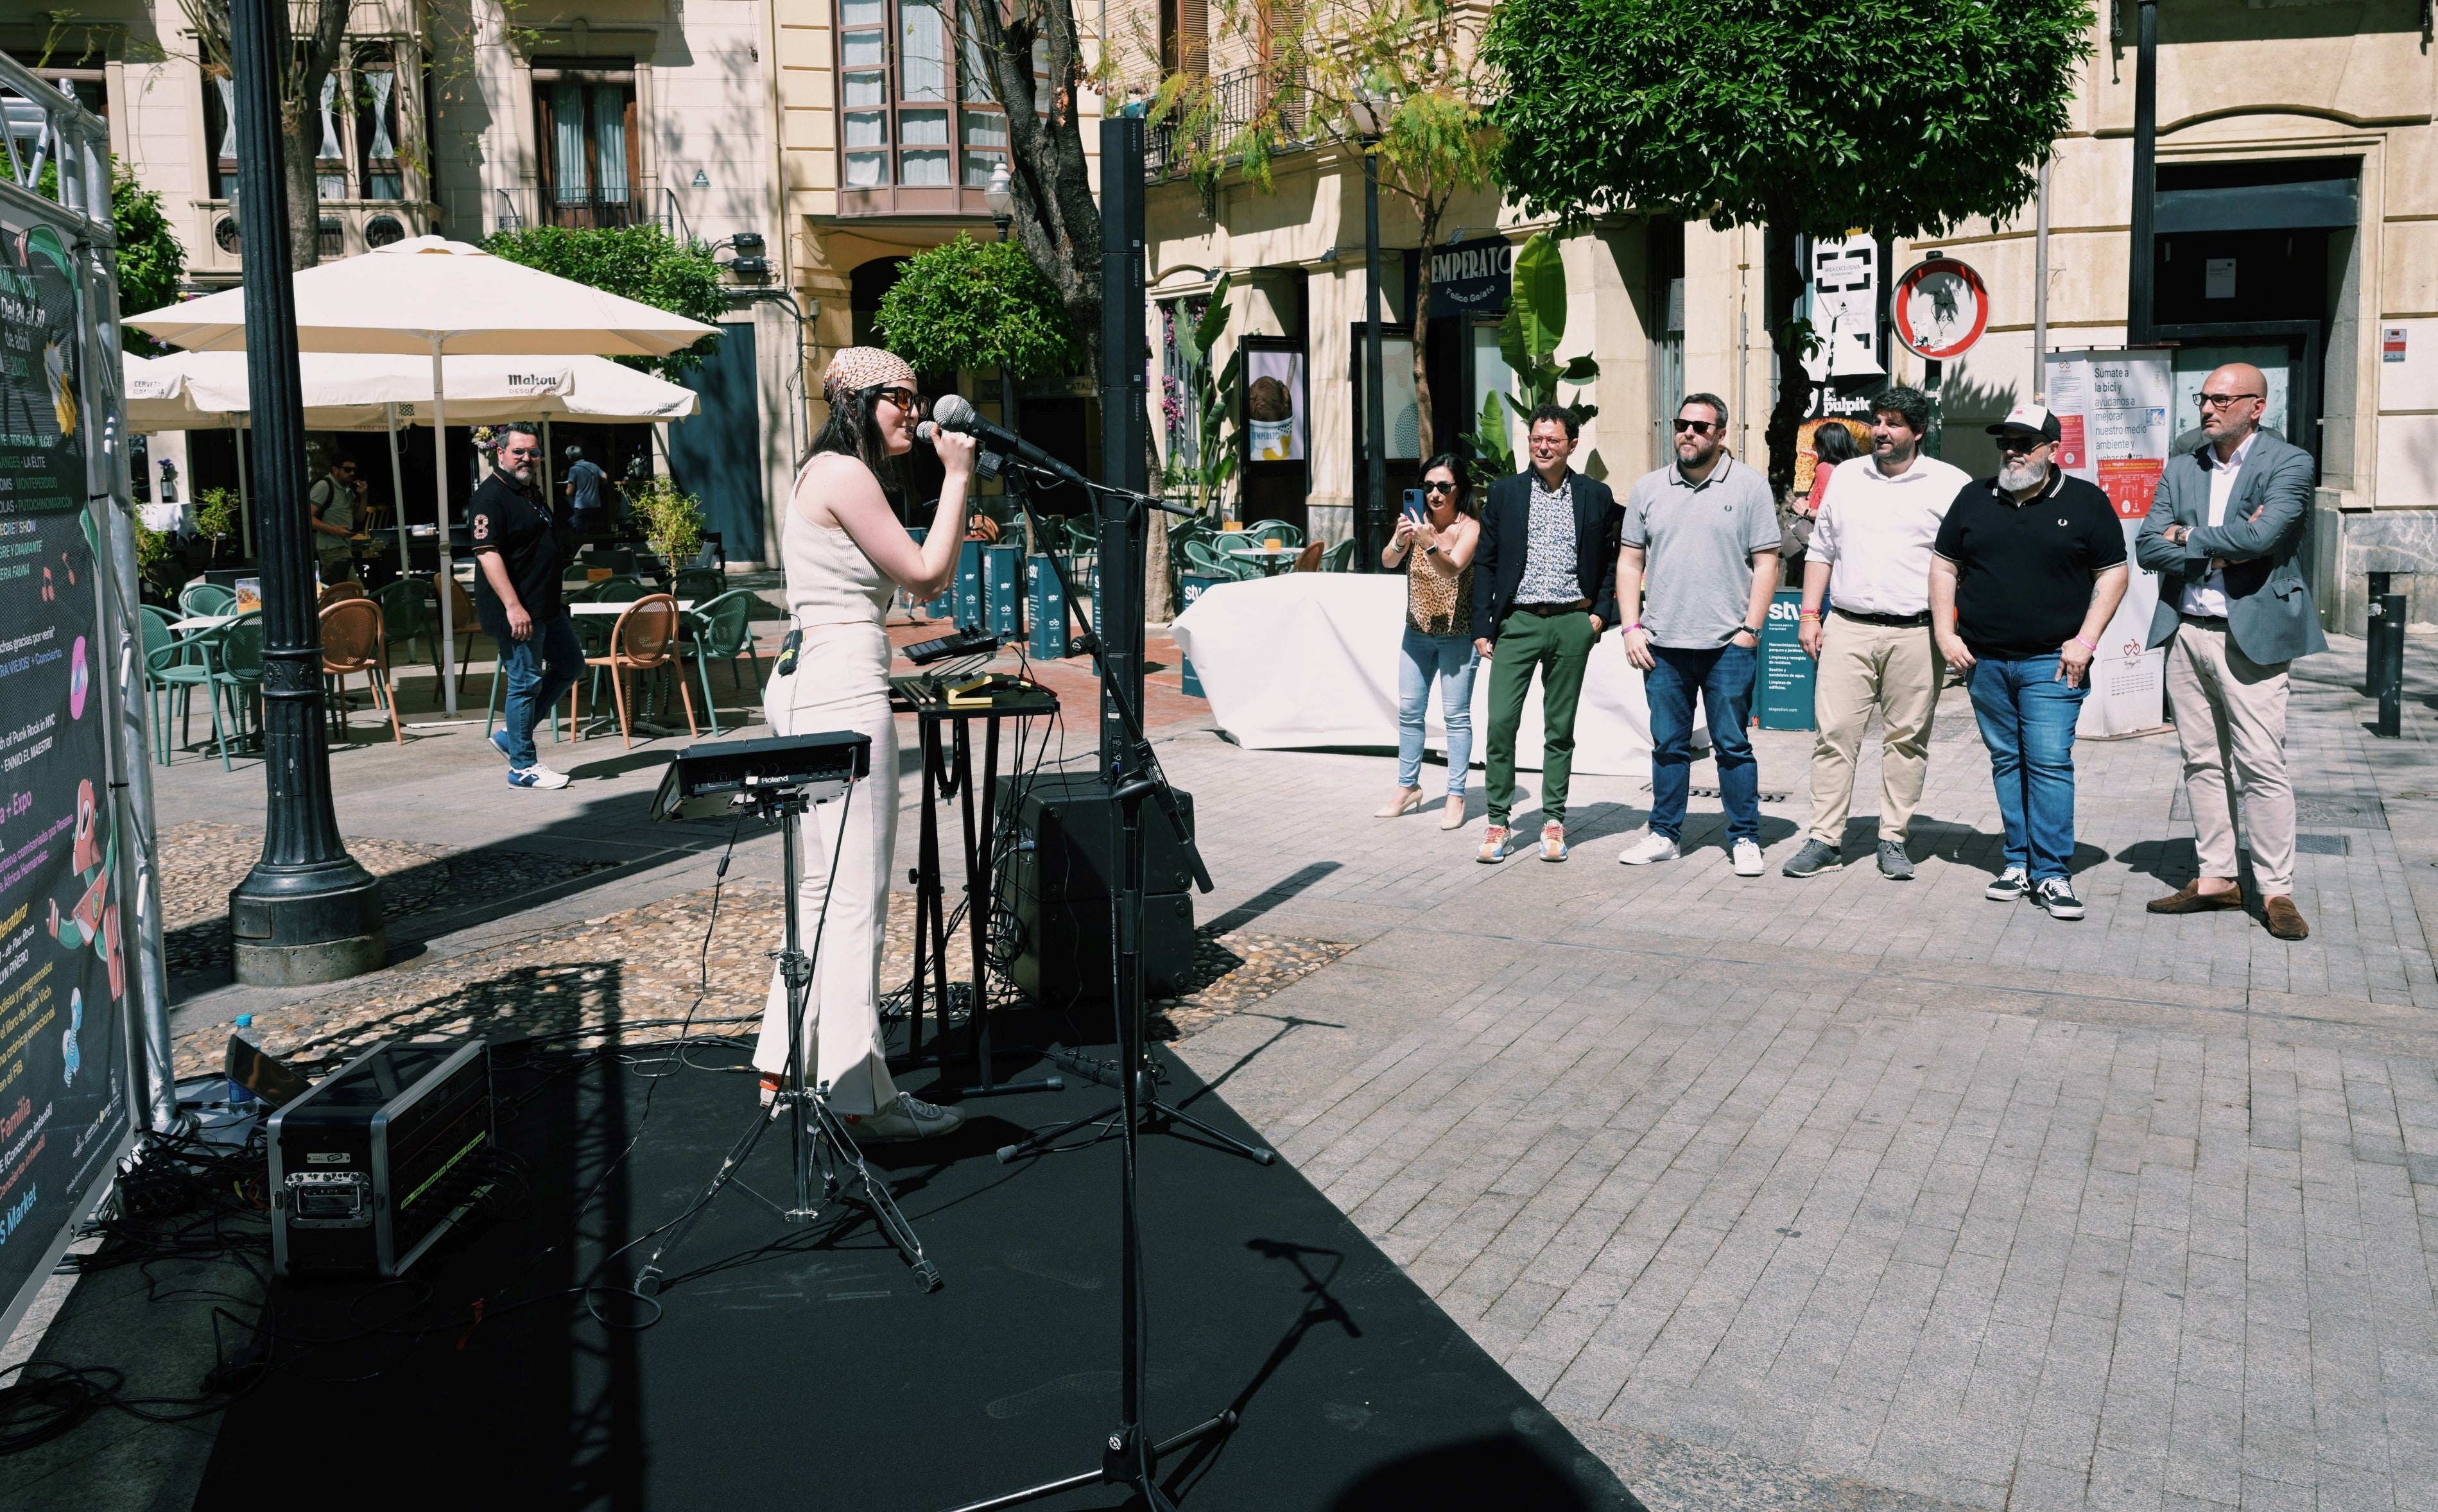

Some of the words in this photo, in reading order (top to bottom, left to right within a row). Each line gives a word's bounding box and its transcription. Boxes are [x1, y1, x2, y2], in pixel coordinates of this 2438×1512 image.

[1431, 245, 1512, 284] EMPERATO
[0, 270, 40, 300] MURCIA
[1446, 287, 1469, 303] Felice
[1, 296, 14, 321] Del
[16, 302, 25, 323] 24
[26, 305, 35, 325] al
[35, 308, 46, 329] 30
[4, 325, 15, 348] de
[15, 329, 31, 352] abril
[10, 355, 30, 378] 2023
[2095, 368, 2123, 378] Súmate
[508, 374, 557, 386] Mahou
[2095, 382, 2102, 392] la
[2103, 382, 2116, 392] bici
[2116, 384, 2122, 394] y
[2095, 397, 2130, 409] ayúdanos
[2131, 397, 2136, 406] a
[2095, 411, 2123, 423] mejorar
[2095, 426, 2123, 436] nuestro
[2125, 424, 2147, 434] medio
[22, 434, 53, 449] ACAPULCO
[1252, 432, 1281, 441] TEMPERATO
[2096, 439, 2130, 451] ambiente
[2131, 440, 2135, 451] y
[23, 457, 31, 468] LA
[31, 454, 46, 468] ÉLITE
[15, 476, 58, 490] MONTEPERDIDO
[19, 520, 37, 533] SHOW
[474, 514, 489, 540] 8
[15, 540, 43, 556] DIAMANTE
[12, 563, 30, 579] FAUNA
[0, 639, 13, 654] chas
[13, 633, 32, 653] gracias
[32, 631, 42, 647] por
[0, 665, 10, 678] RA
[35, 648, 62, 666] Concierto
[6, 733, 12, 748] of
[13, 726, 27, 744] Punk
[27, 722, 40, 737] Rock
[40, 719, 46, 732] in
[45, 713, 56, 730] NYC
[4, 752, 22, 773] ENNIO
[22, 749, 31, 764] EL
[31, 735, 53, 759] MAESTRO
[761, 775, 789, 784] Roland
[13, 791, 32, 817] Expo
[48, 827, 57, 842] por
[56, 814, 74, 833] Rosana
[5, 943, 12, 958] de
[12, 936, 22, 952] Pau
[22, 924, 35, 943] Roca
[9, 949, 29, 977] PIÑERO
[20, 961, 54, 1000] programador
[5, 1015, 19, 1035] libro
[19, 1007, 27, 1024] de
[26, 997, 40, 1017] Joan
[39, 984, 53, 1004] Vich
[27, 1003, 56, 1040] emocional
[6, 1068, 13, 1085] el
[12, 1059, 23, 1081] FIB
[0, 1095, 31, 1144] Familia
[4, 1127, 33, 1171] (Concierto
[33, 1100, 53, 1135] infantil)
[7, 1181, 37, 1236] Market
